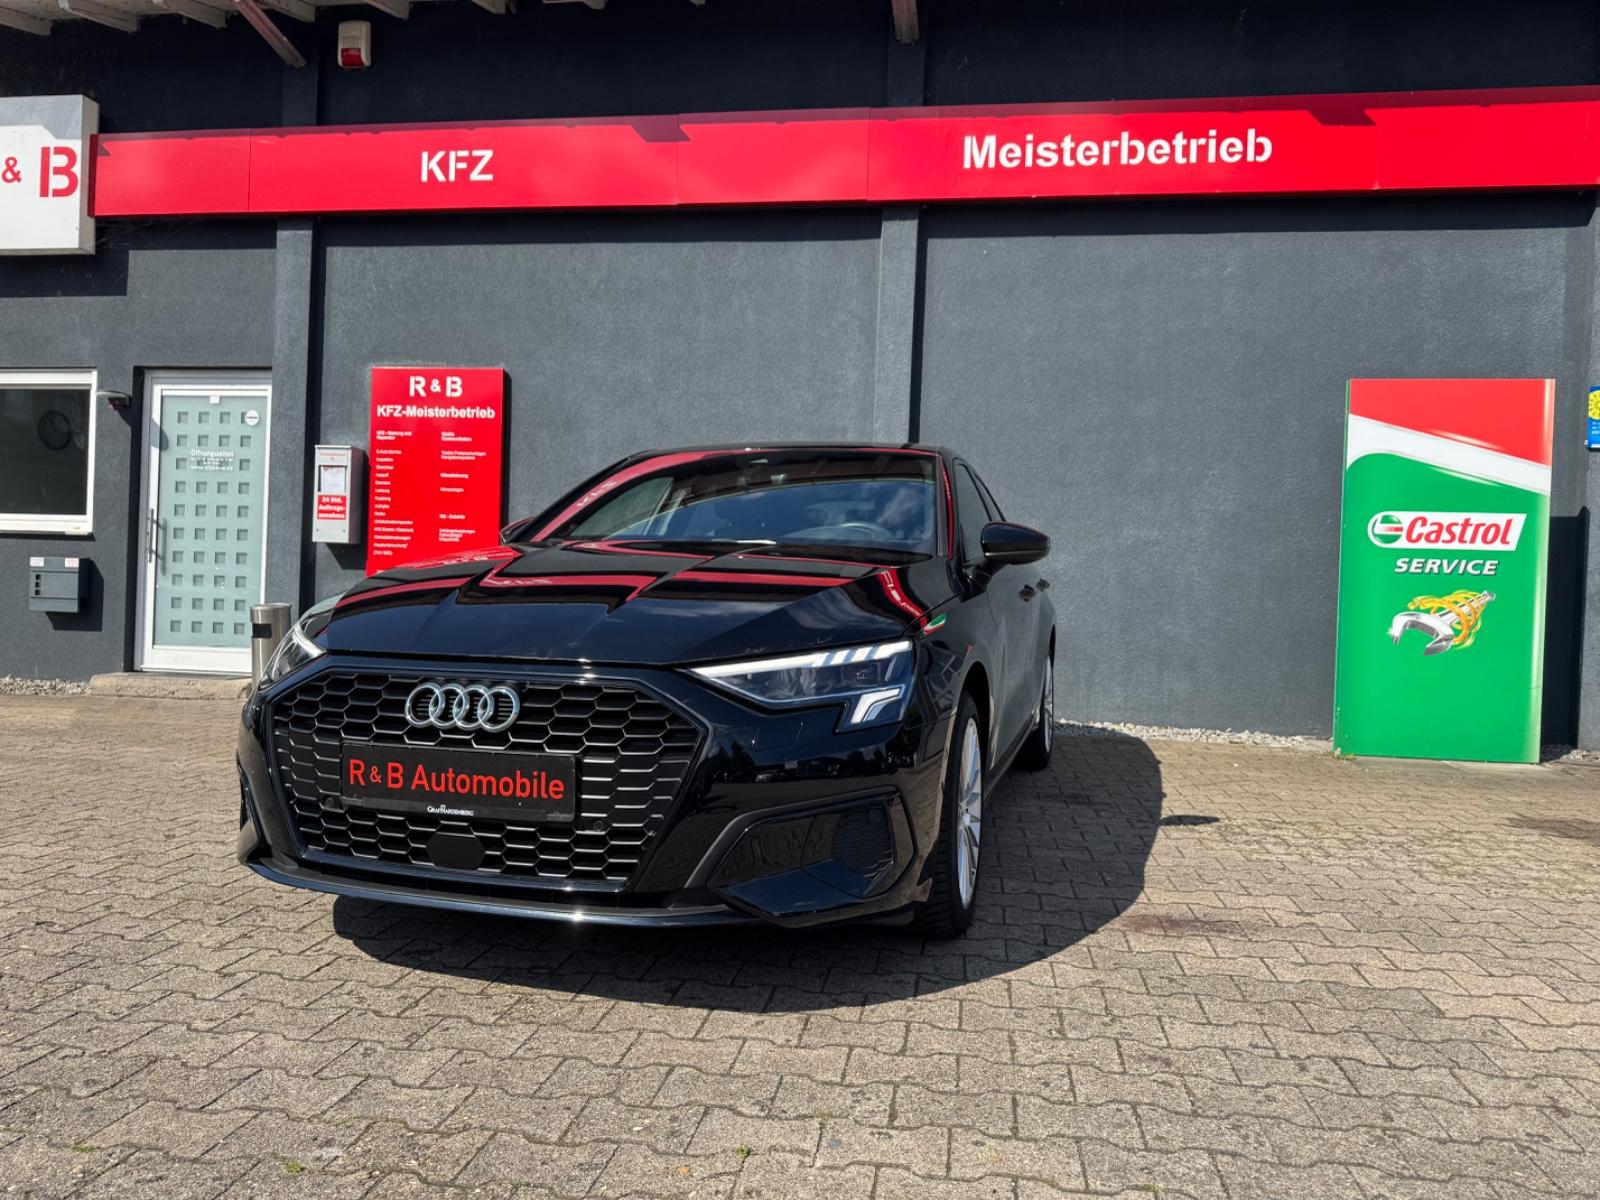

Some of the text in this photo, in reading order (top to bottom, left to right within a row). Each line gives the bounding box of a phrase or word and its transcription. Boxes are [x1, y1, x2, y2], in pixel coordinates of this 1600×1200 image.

[421, 128, 1273, 183] KFZ Meisterbetrieb
[1, 146, 79, 198] & B
[409, 375, 463, 397] R & B
[376, 404, 496, 419] KFZ-Meisterbetrieb
[1405, 516, 1514, 545] Castrol
[1394, 557, 1499, 576] SERVICE
[349, 758, 565, 800] R & B Automobile
